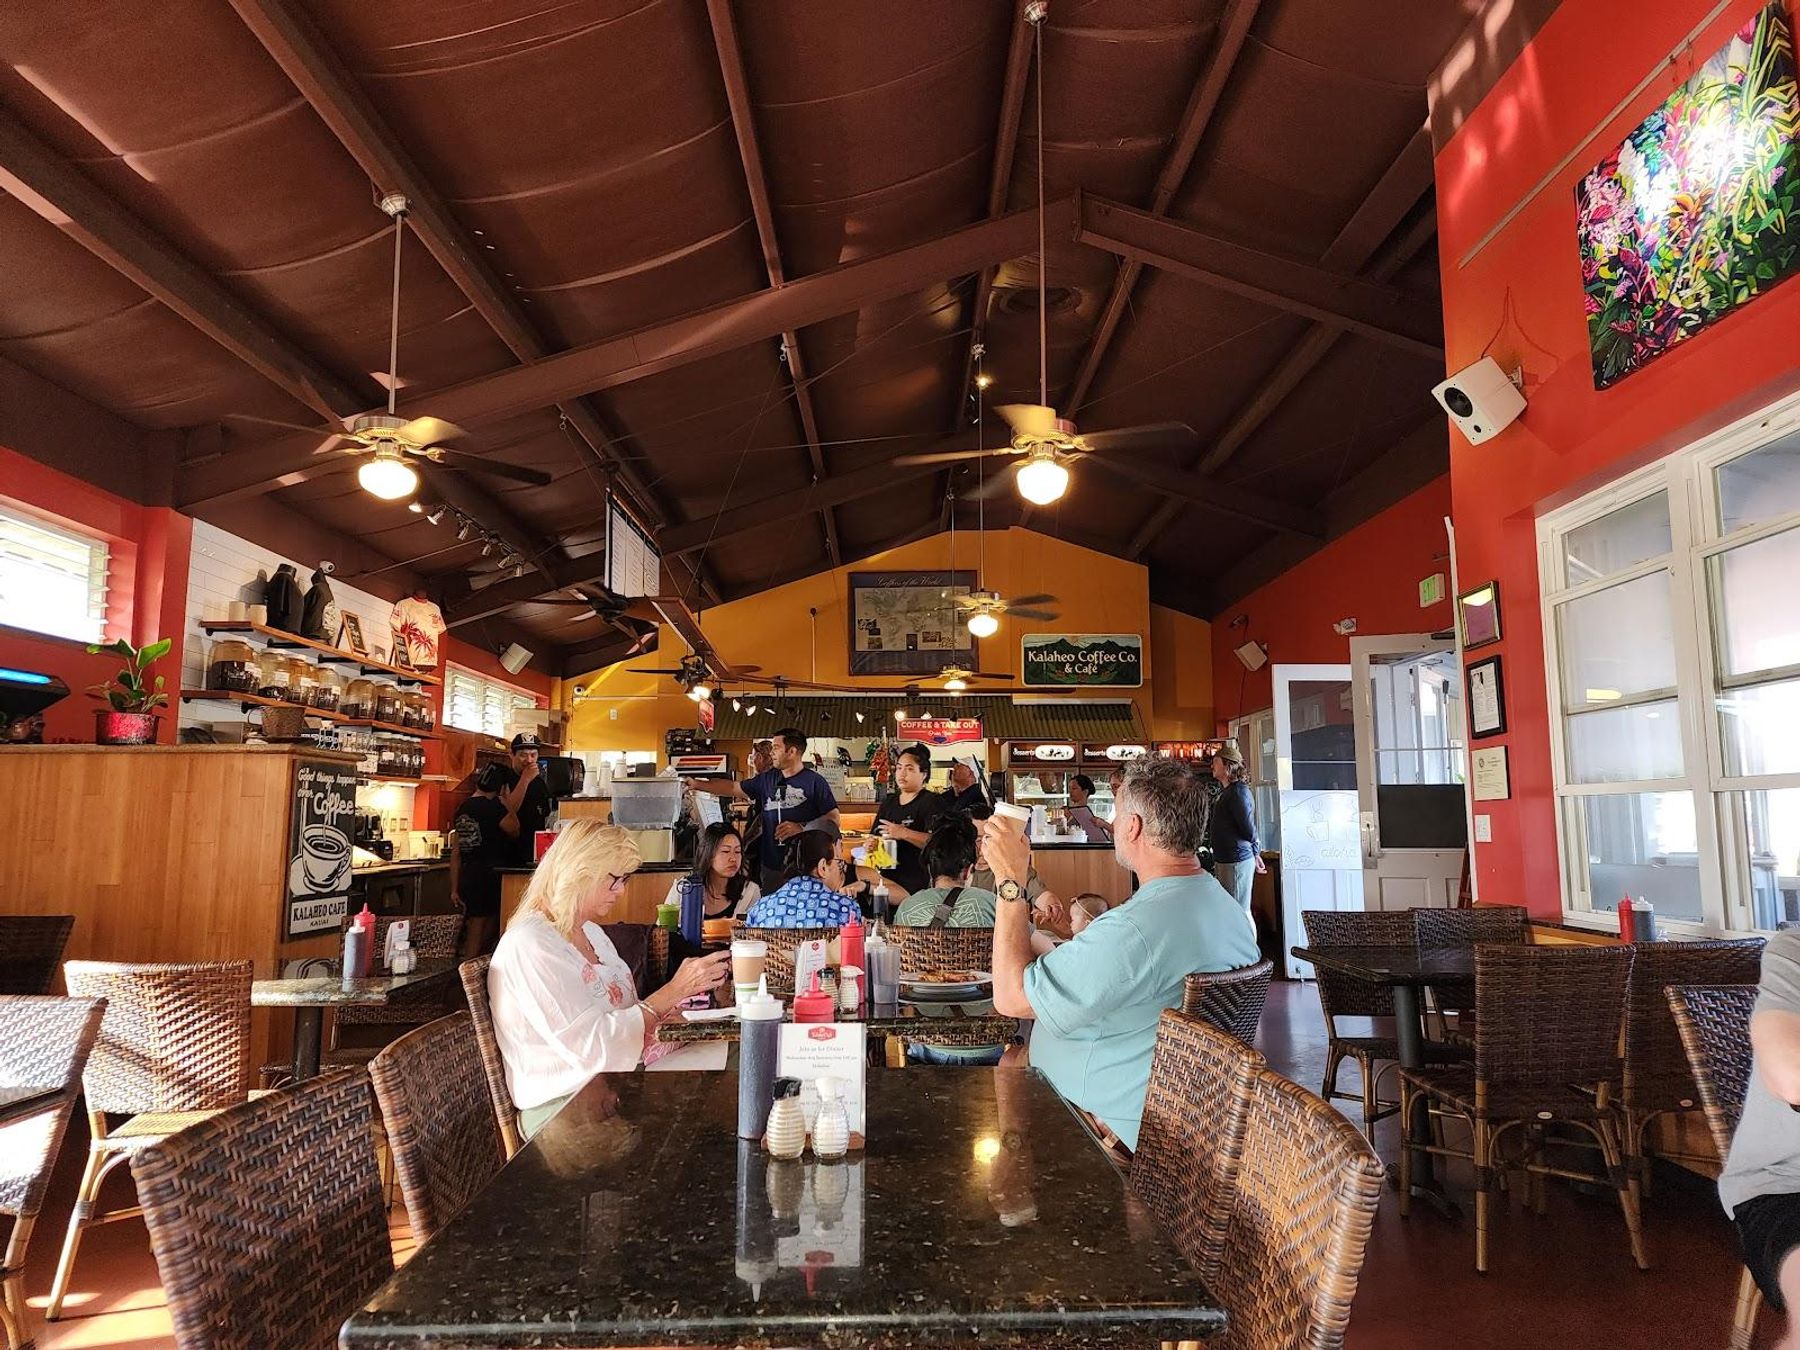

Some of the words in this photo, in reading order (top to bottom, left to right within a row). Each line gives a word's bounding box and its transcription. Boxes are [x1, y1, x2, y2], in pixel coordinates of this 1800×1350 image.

[1028, 651, 1075, 662] Kalaheo
[1078, 650, 1117, 664] Coffee
[1118, 651, 1137, 662] Co.
[1064, 663, 1073, 673] &
[901, 721, 932, 729] COFFEE
[933, 721, 940, 729] &
[941, 721, 961, 729] TAKE
[962, 721, 979, 729] OUT
[297, 768, 316, 781] Good
[313, 792, 354, 822] Coffee
[293, 904, 328, 921] KALAHEO
[328, 901, 346, 916] CAFE
